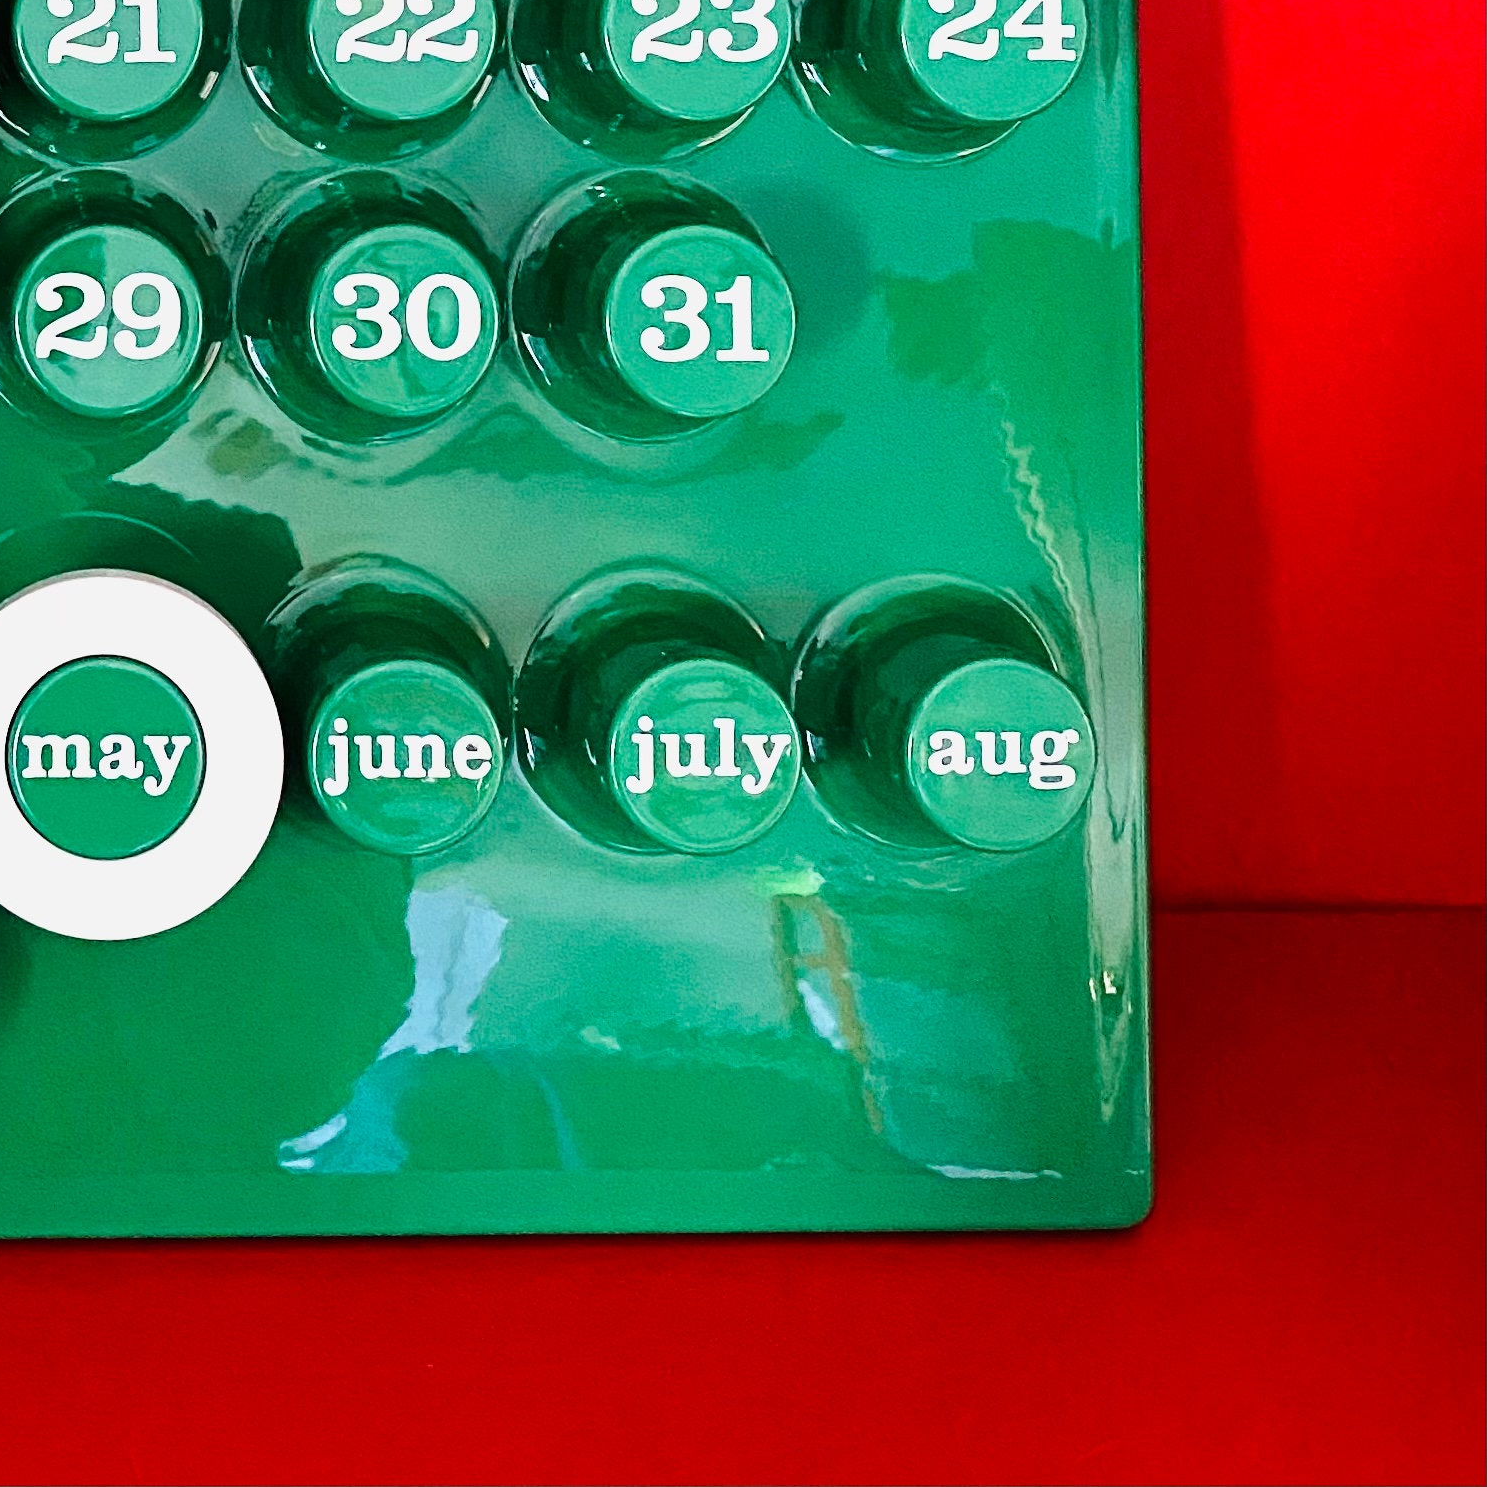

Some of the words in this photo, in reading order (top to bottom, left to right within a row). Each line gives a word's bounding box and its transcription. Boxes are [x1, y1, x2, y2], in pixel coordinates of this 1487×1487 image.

[34, 271, 182, 361] 29
[330, 272, 482, 362] 30
[639, 273, 771, 364] 31
[20, 733, 192, 798] may
[322, 716, 493, 797] june
[624, 714, 793, 796] july
[927, 728, 1081, 791] aug
